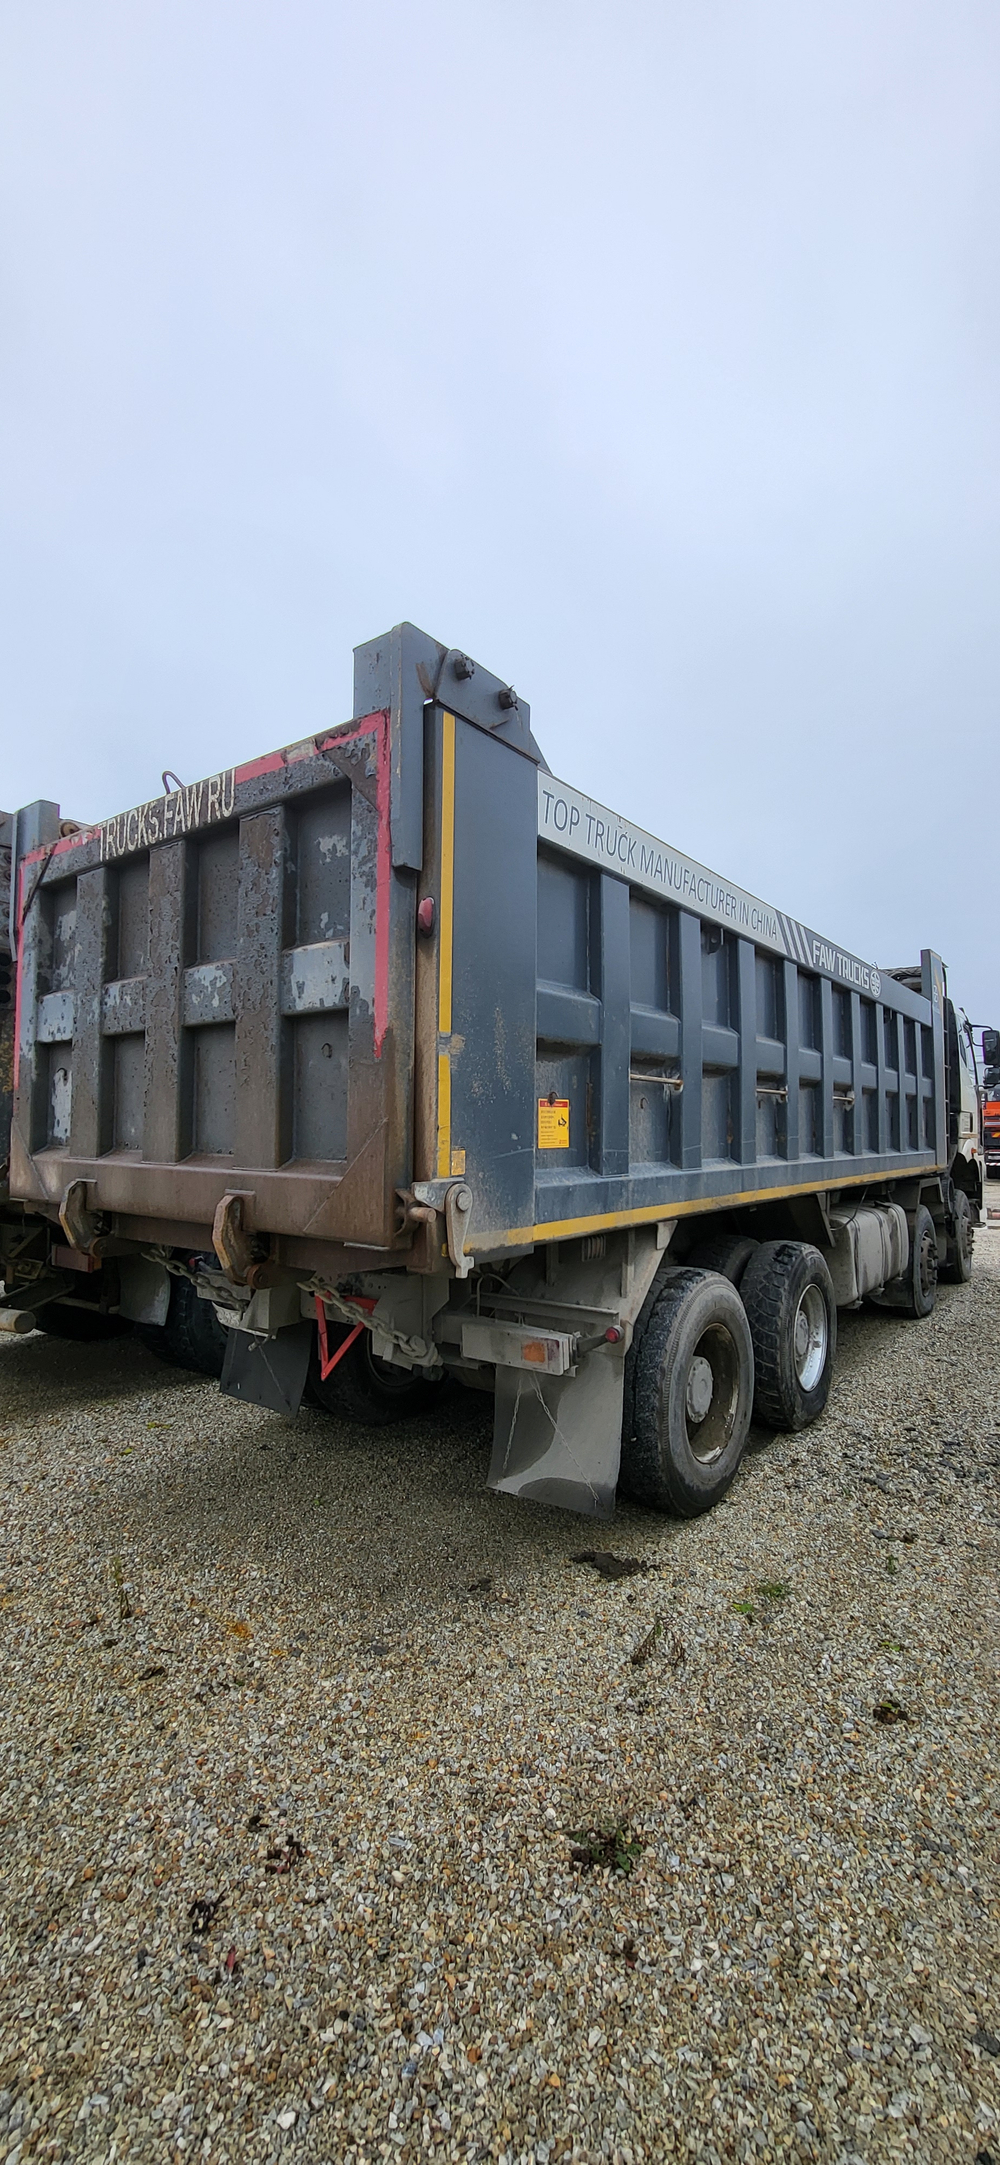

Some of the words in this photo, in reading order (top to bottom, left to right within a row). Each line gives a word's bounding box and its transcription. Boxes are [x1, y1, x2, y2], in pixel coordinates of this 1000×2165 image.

[207, 768, 236, 823] RU
[542, 789, 581, 836] TOP
[585, 813, 638, 869] TRUCK
[640, 844, 737, 920] MANUFACTURER
[739, 900, 750, 927] IN
[751, 908, 778, 941] CHINA
[812, 939, 836, 973] FAW
[836, 952, 870, 990] TRUCKS
